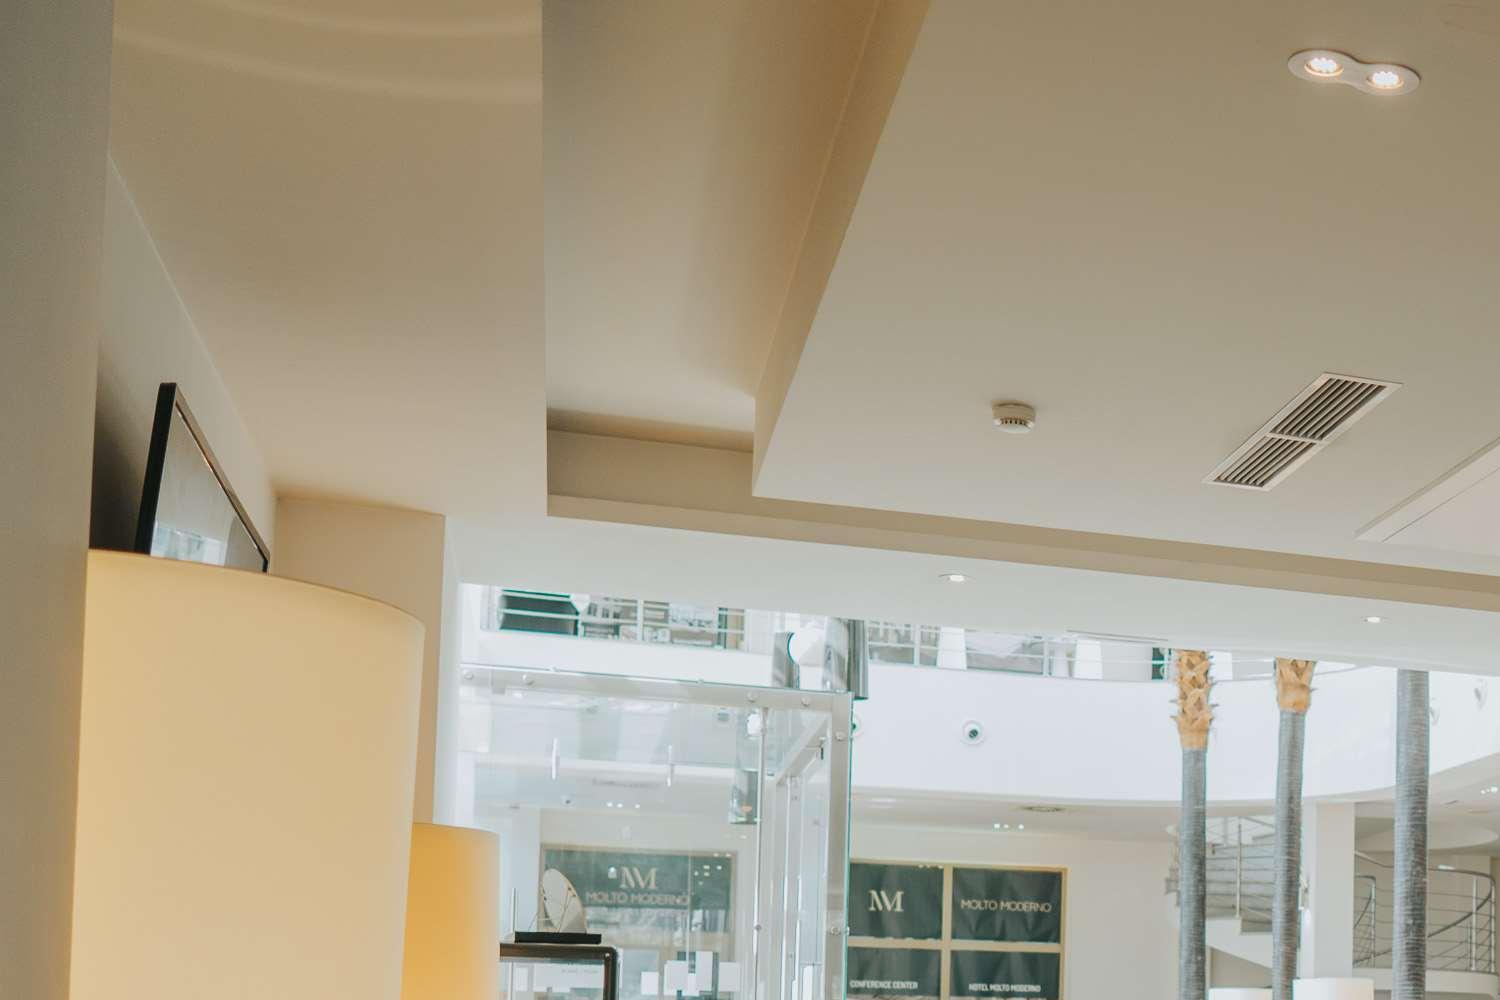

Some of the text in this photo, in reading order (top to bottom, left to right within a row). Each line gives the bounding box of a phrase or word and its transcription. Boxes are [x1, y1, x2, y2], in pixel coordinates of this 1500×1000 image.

[960, 899, 1052, 913] MOLTO MODERNO
[849, 980, 918, 990] CONFERENCE CENTER
[969, 983, 1041, 993] HOTEL MOLTO MODERNO
